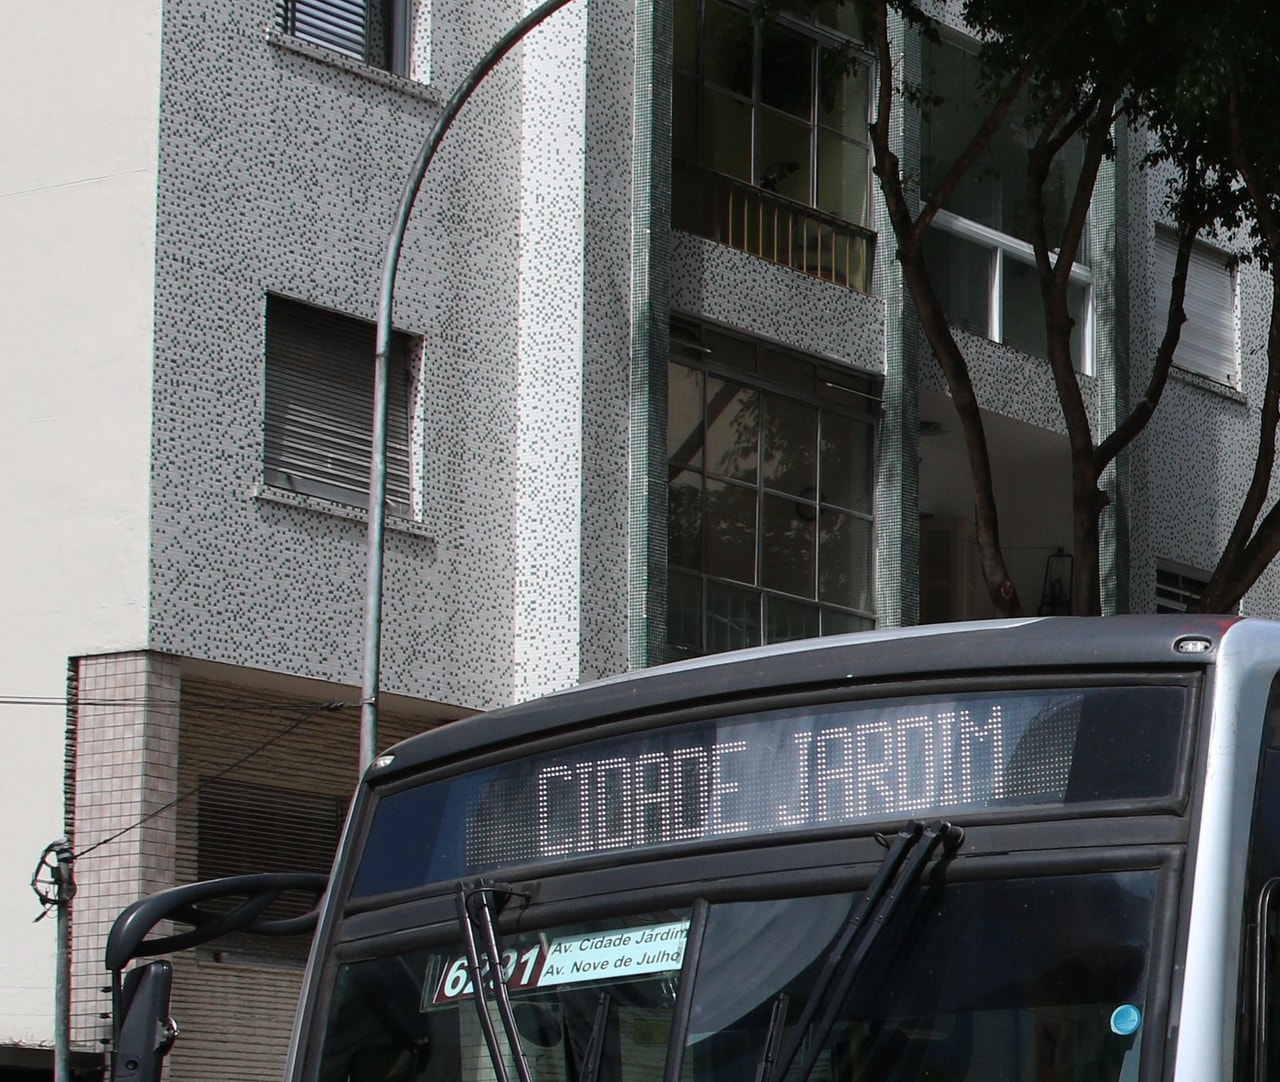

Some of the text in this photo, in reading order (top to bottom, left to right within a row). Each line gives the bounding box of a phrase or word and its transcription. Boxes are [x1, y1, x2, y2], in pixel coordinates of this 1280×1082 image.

[538, 705, 1003, 857] CIDADE JARDIM
[551, 927, 689, 956] Av. Cidade Jardim
[543, 950, 681, 978] Av. Nove de Julho
